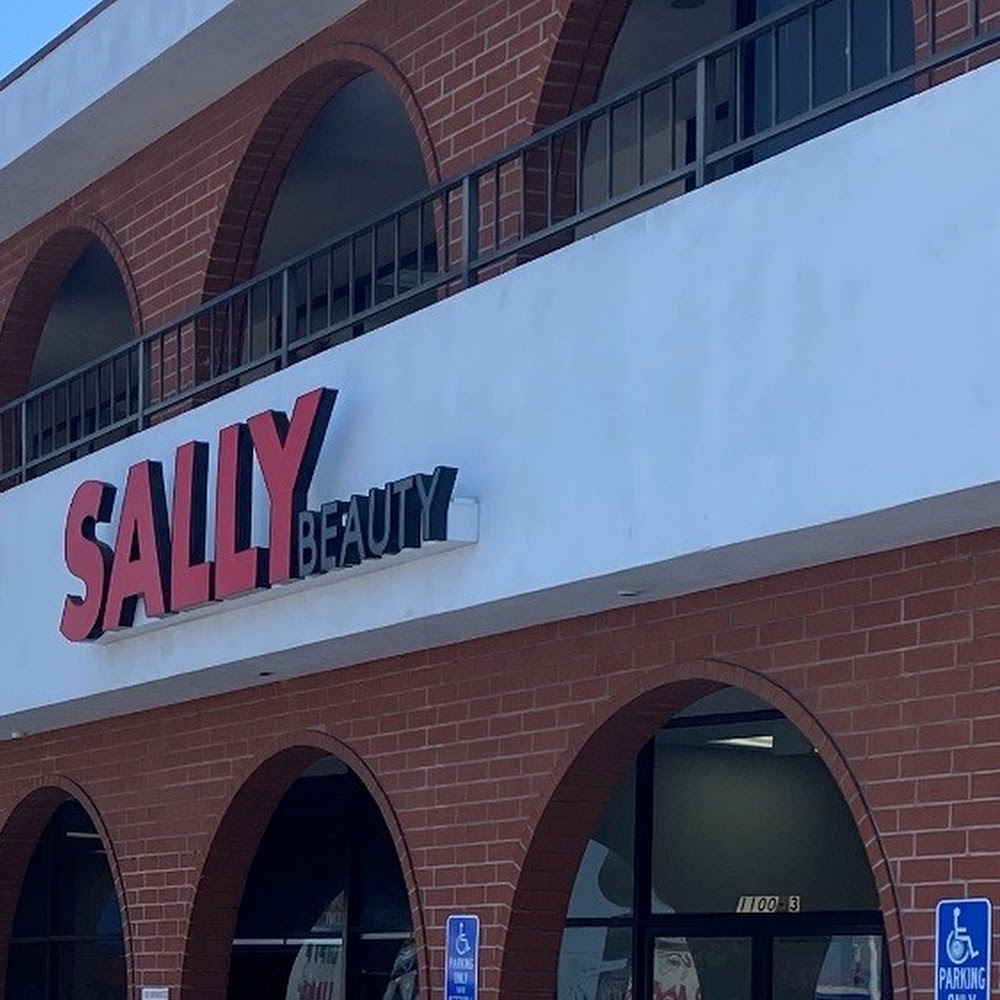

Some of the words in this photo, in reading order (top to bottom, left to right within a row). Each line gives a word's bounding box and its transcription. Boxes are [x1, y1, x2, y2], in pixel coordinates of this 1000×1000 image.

[60, 387, 339, 643] SALLY
[299, 466, 458, 579] BEAUTY
[939, 967, 986, 990] PARKING
